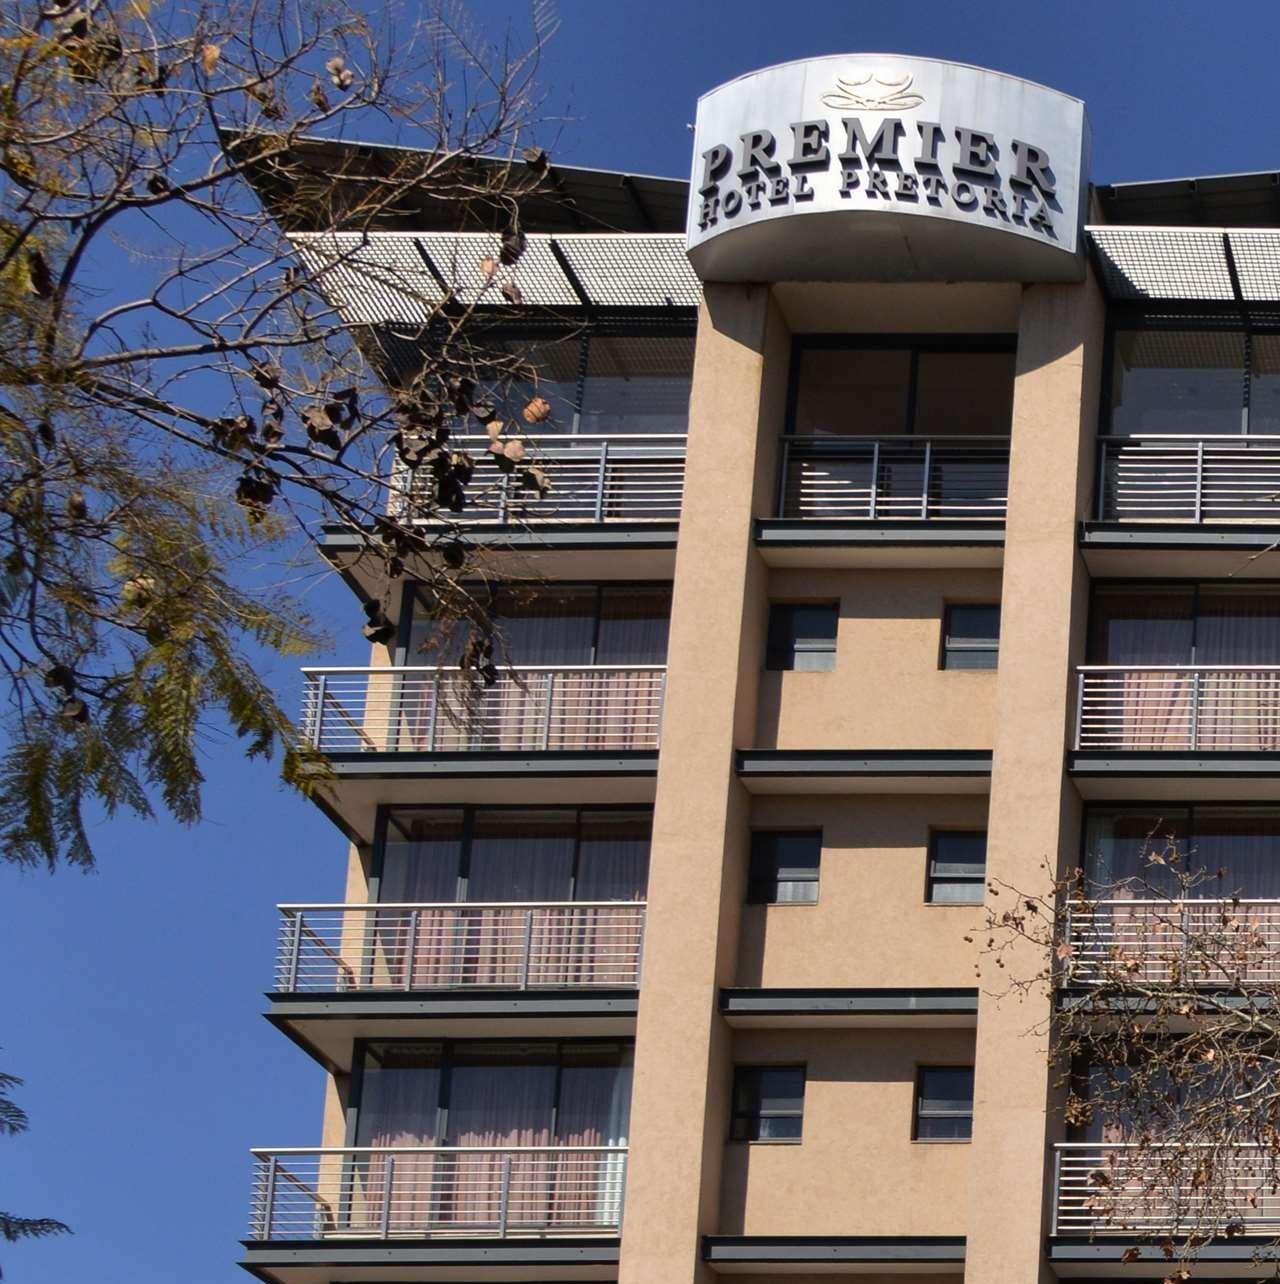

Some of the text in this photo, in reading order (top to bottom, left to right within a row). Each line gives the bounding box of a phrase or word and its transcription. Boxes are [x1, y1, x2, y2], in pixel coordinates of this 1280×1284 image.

[700, 117, 1061, 200] PREMIER
[698, 169, 1057, 238] HOTEL PRETORIA
